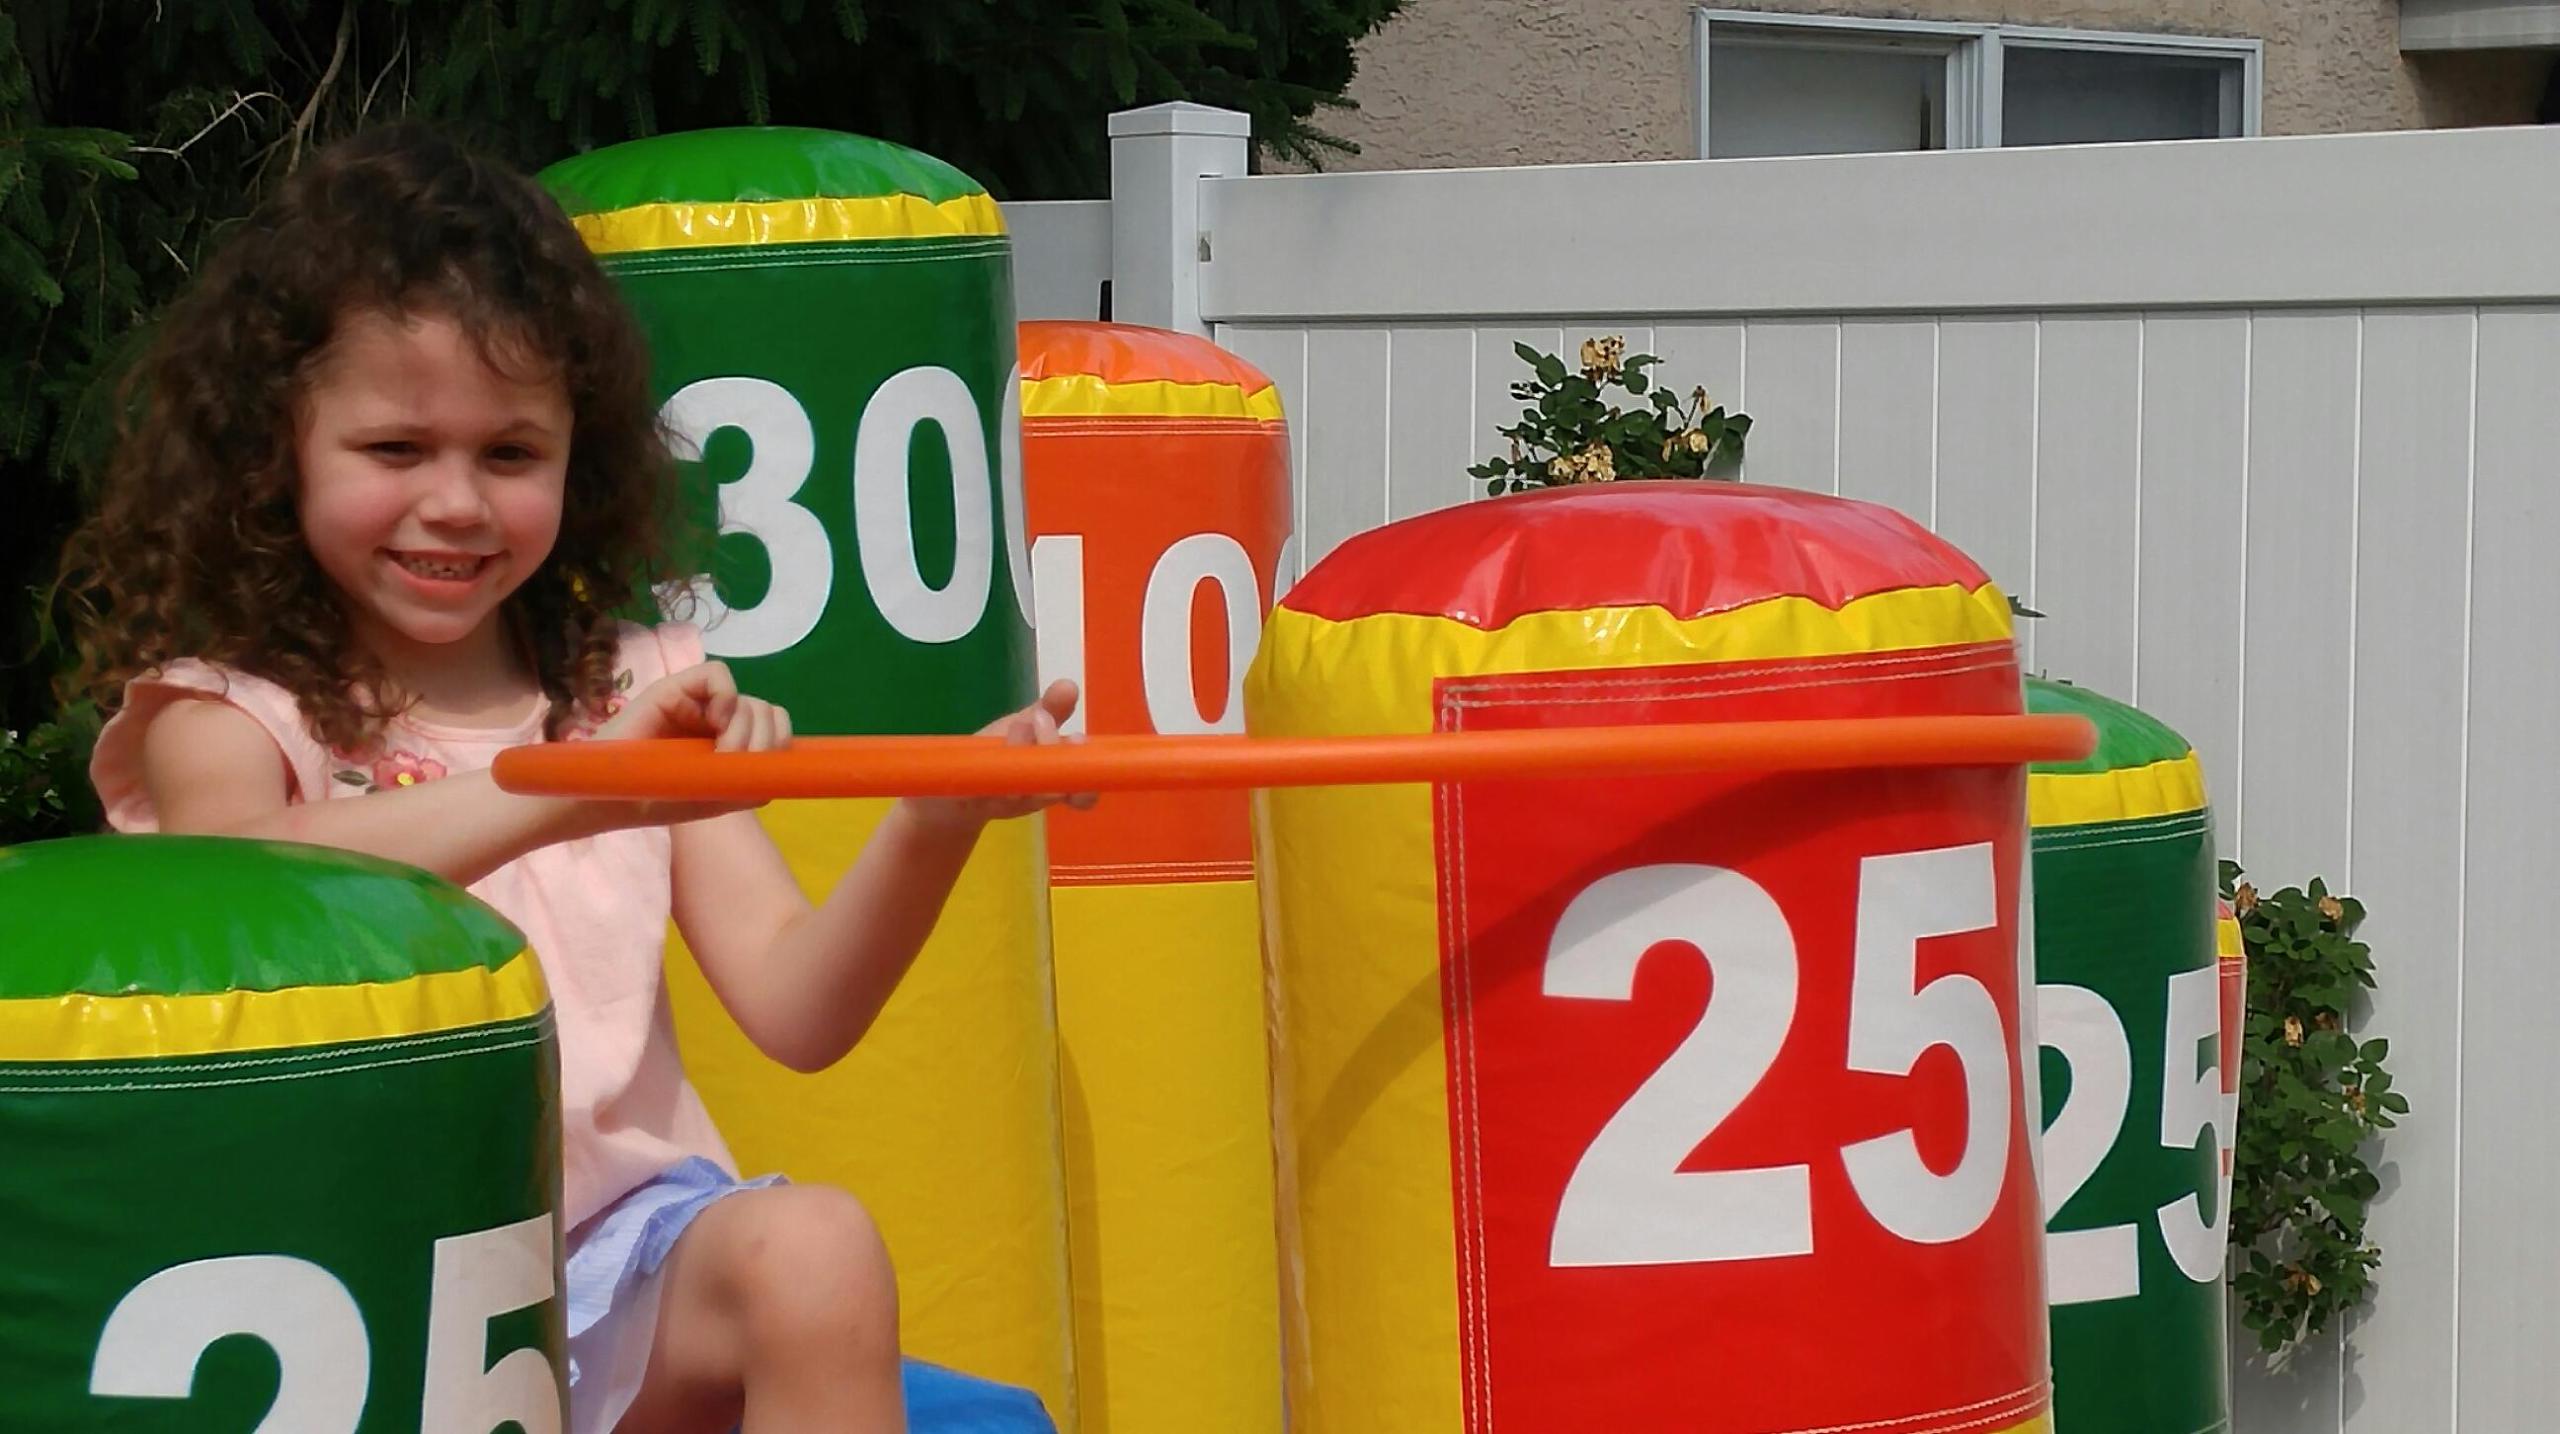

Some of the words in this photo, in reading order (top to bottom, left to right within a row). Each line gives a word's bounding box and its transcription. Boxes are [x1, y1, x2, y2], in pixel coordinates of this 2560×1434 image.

[657, 366, 1036, 658] 30
[1031, 533, 1294, 735] 10
[1542, 826, 2044, 1267] 25
